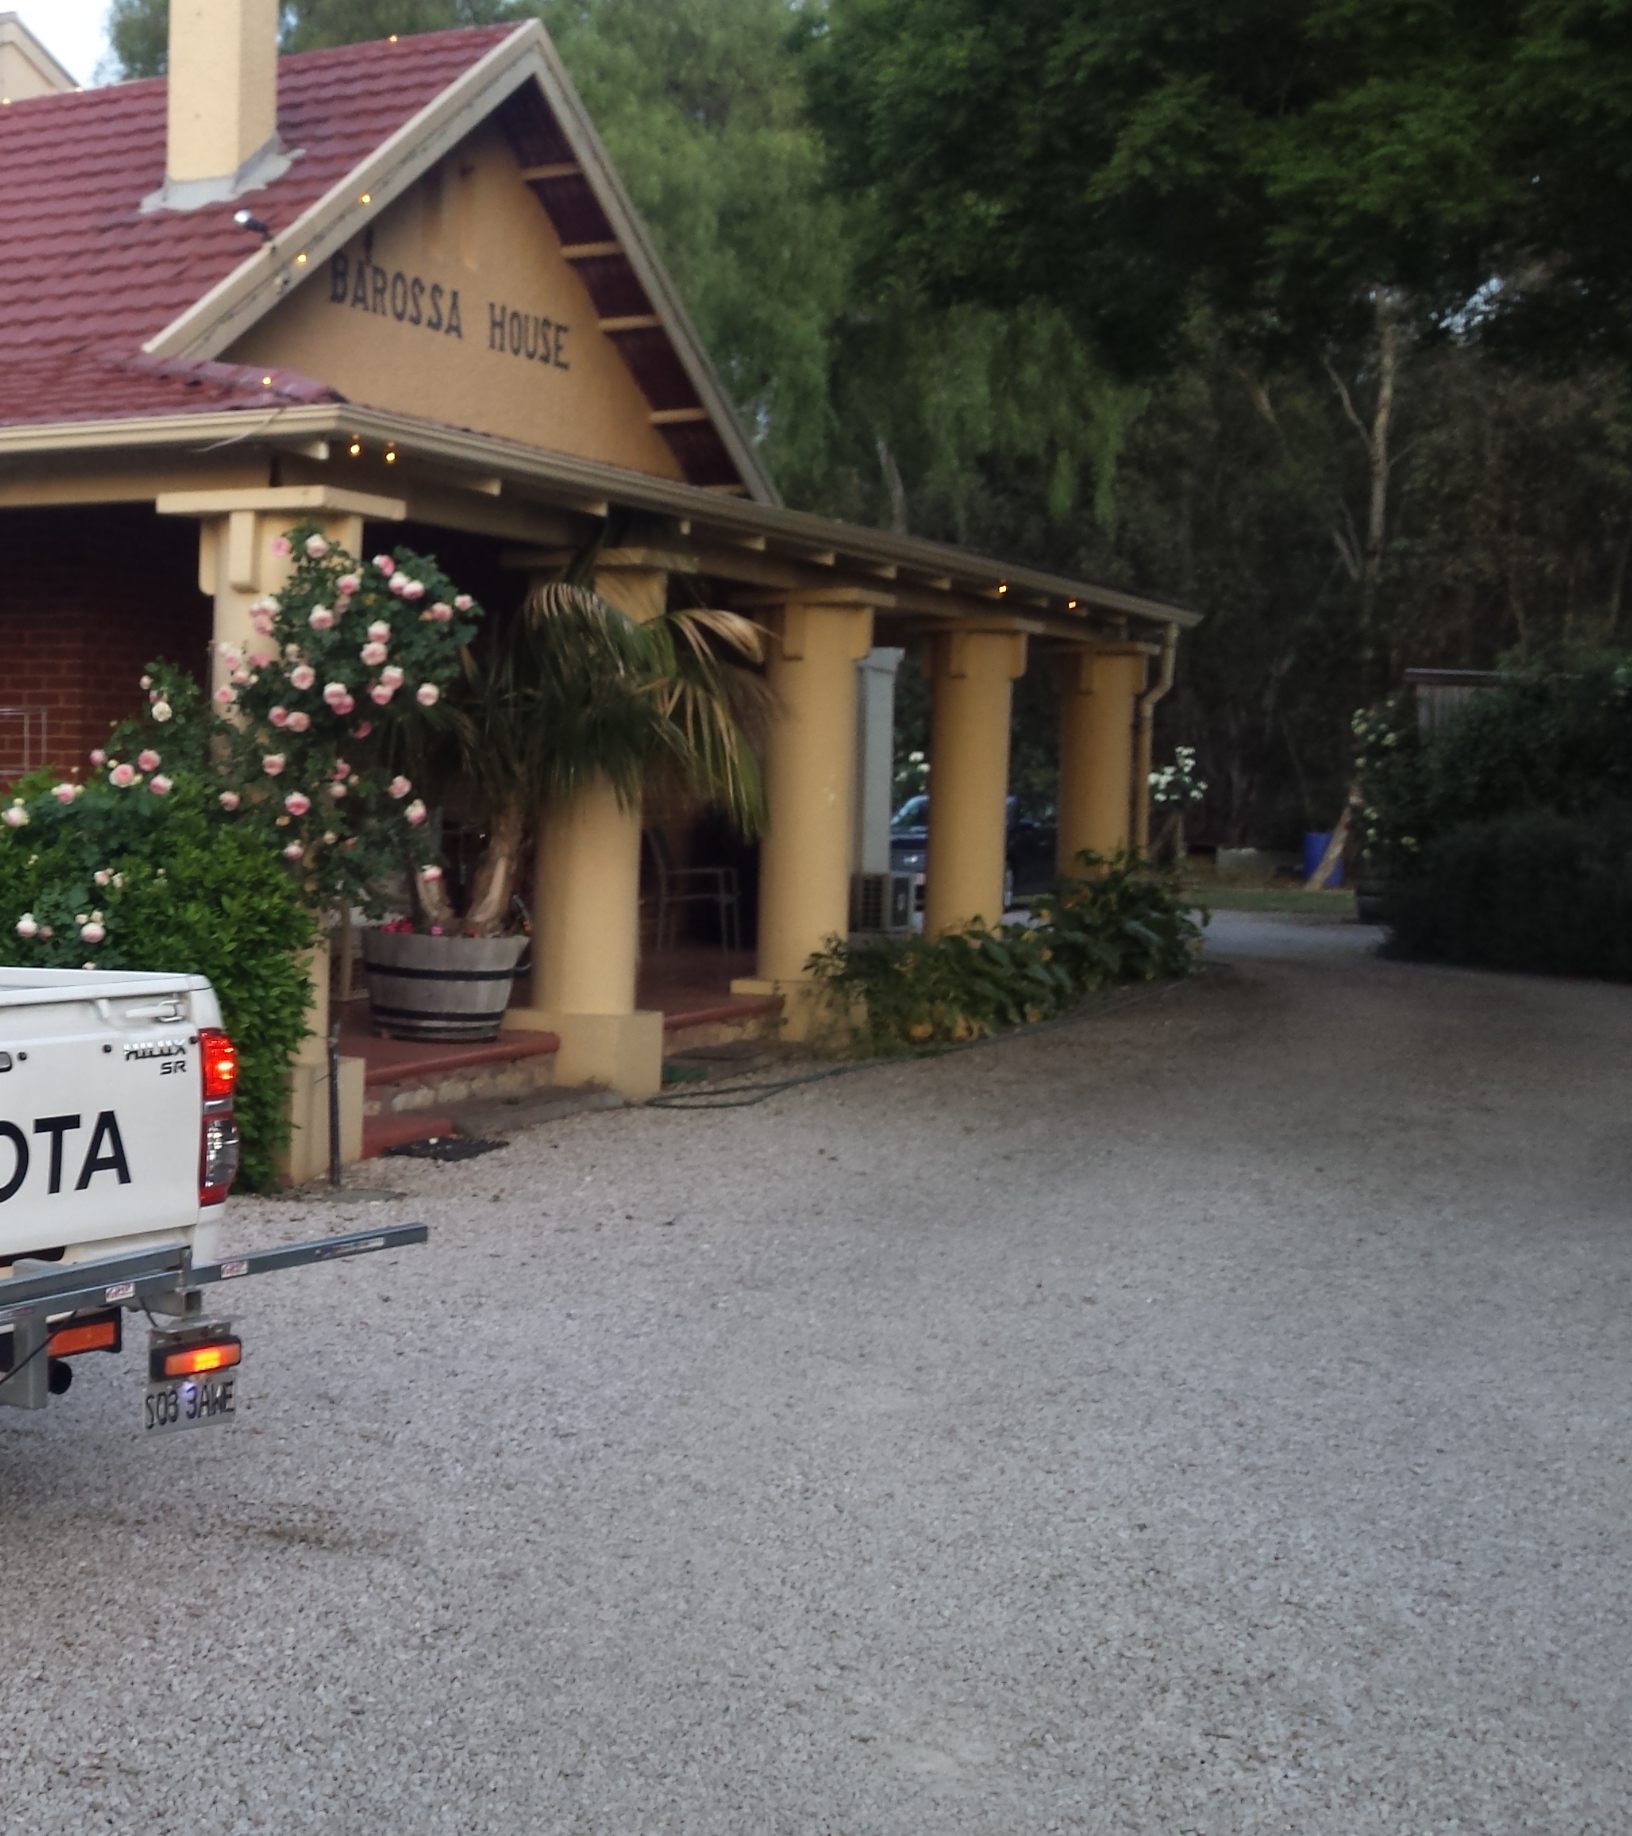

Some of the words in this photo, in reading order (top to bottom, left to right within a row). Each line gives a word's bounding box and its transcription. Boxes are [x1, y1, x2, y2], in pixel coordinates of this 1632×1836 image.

[329, 250, 463, 339] BAROSSA
[488, 302, 570, 370] HOUSE
[123, 1039, 186, 1061] HILUX
[160, 1060, 186, 1075] SR
